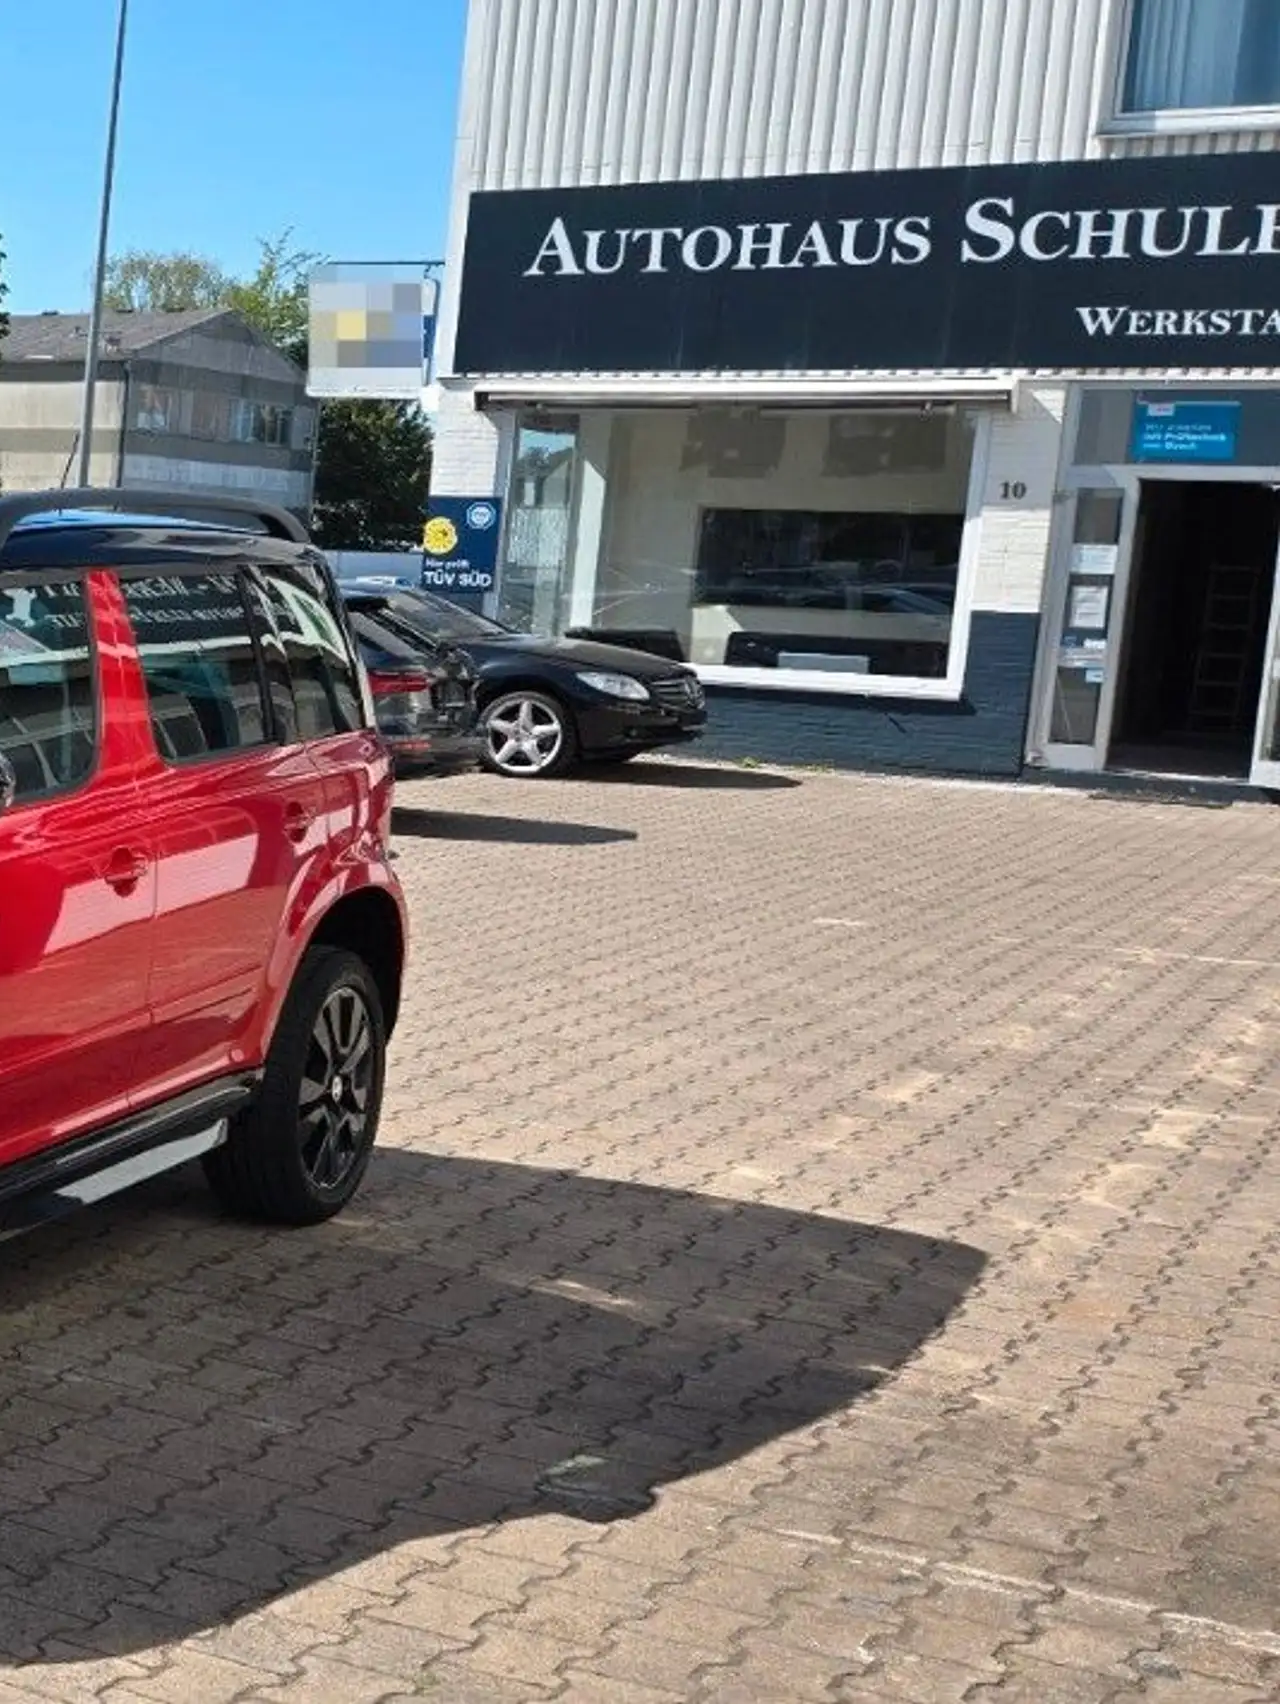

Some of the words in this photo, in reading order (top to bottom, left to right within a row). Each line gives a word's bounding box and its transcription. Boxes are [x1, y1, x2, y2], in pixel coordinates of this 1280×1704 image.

[522, 215, 932, 277] AUTOHAUS
[999, 480, 1028, 501] 10
[423, 568, 456, 586] TÜV
[459, 569, 492, 588] SÜD
